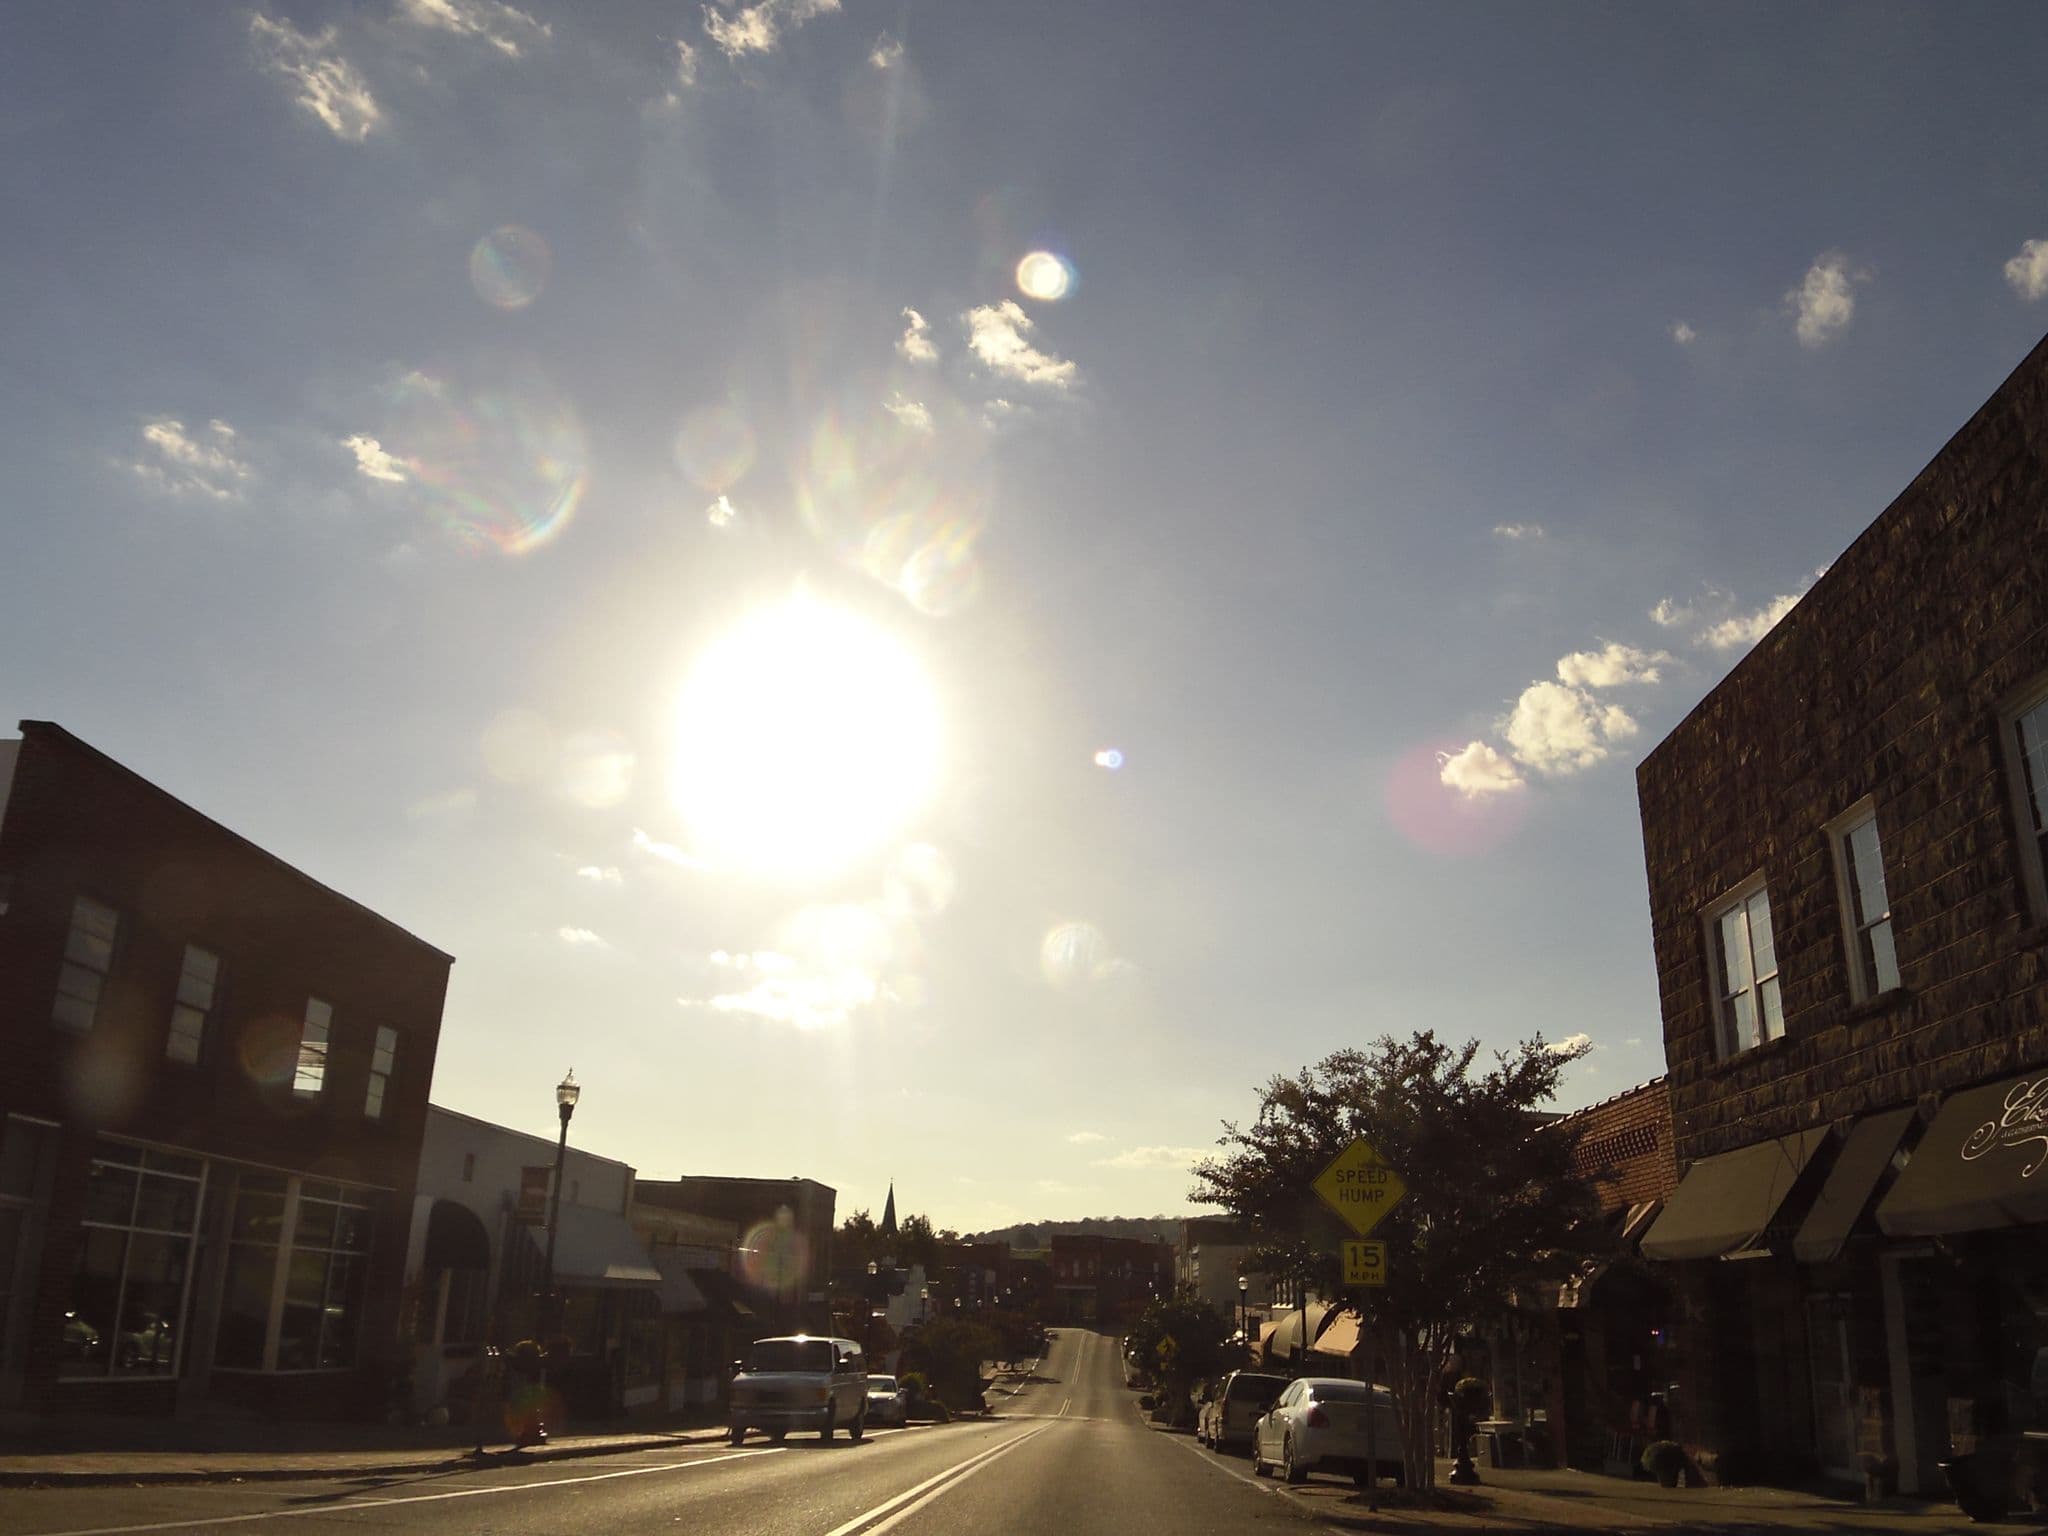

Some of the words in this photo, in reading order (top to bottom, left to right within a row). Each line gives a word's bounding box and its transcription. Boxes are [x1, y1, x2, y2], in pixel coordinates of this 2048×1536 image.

[1336, 1170, 1388, 1184] SPEED
[1339, 1188, 1385, 1203] HUMP
[1350, 1246, 1380, 1268] 15
